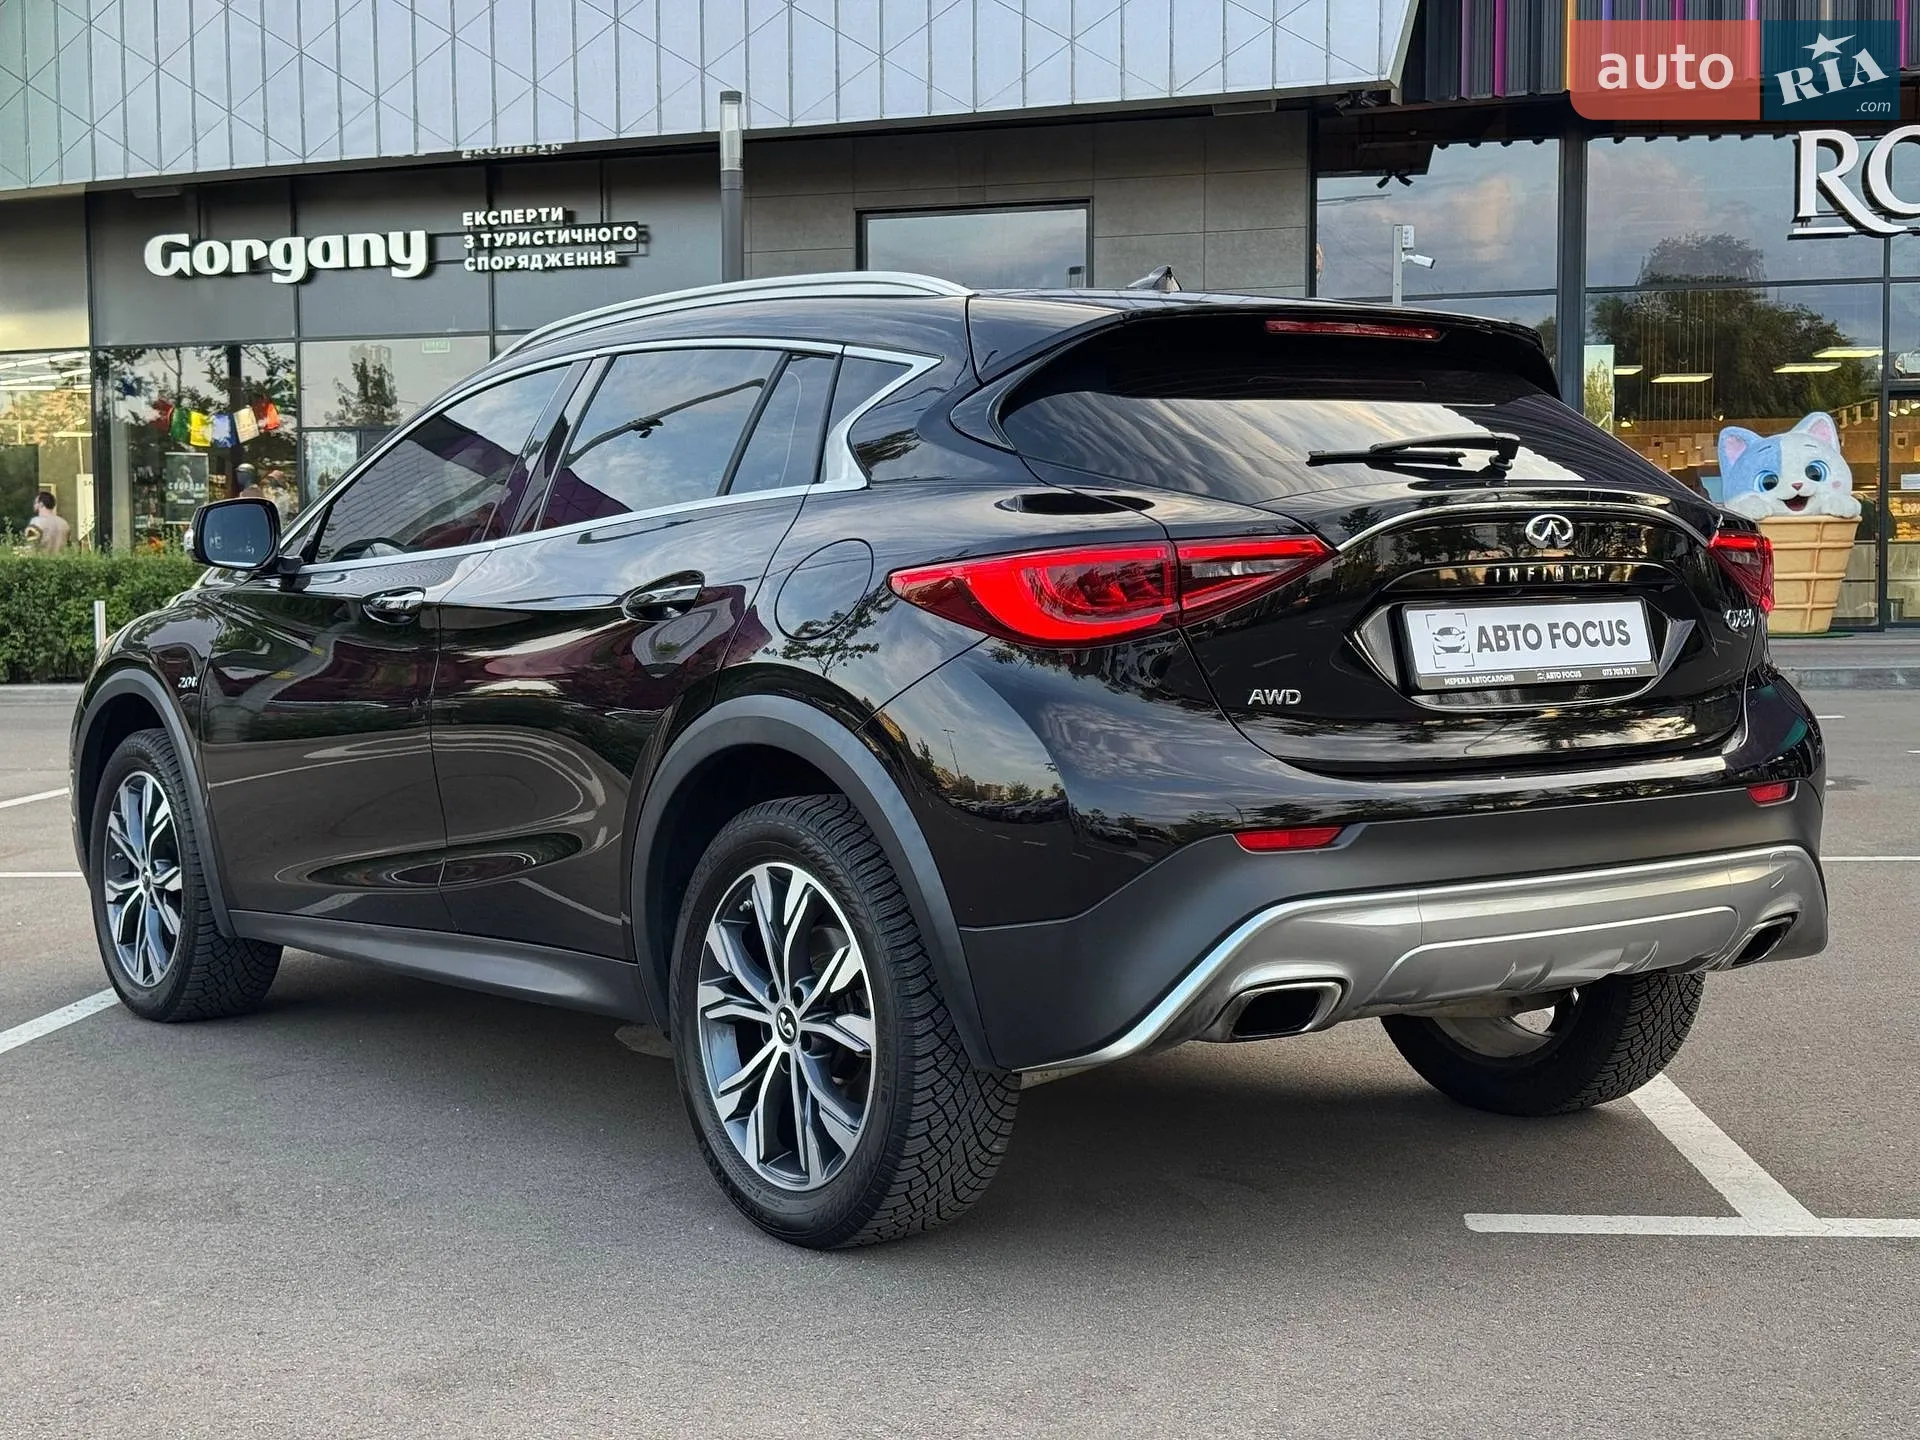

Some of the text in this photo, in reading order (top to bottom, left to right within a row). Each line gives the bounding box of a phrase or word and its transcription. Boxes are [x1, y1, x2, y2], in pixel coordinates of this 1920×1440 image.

[462, 206, 564, 226] ЕКСПЕРТИ
[480, 226, 637, 248] ТУРИСТИЧНОГО
[143, 229, 429, 284] Gorgany
[464, 250, 617, 271] СПОРЯДЖЕННЯ
[1495, 565, 1603, 583] INFINITI
[1476, 618, 1631, 653] АВТО FOCUS
[1247, 688, 1302, 706] AWD
